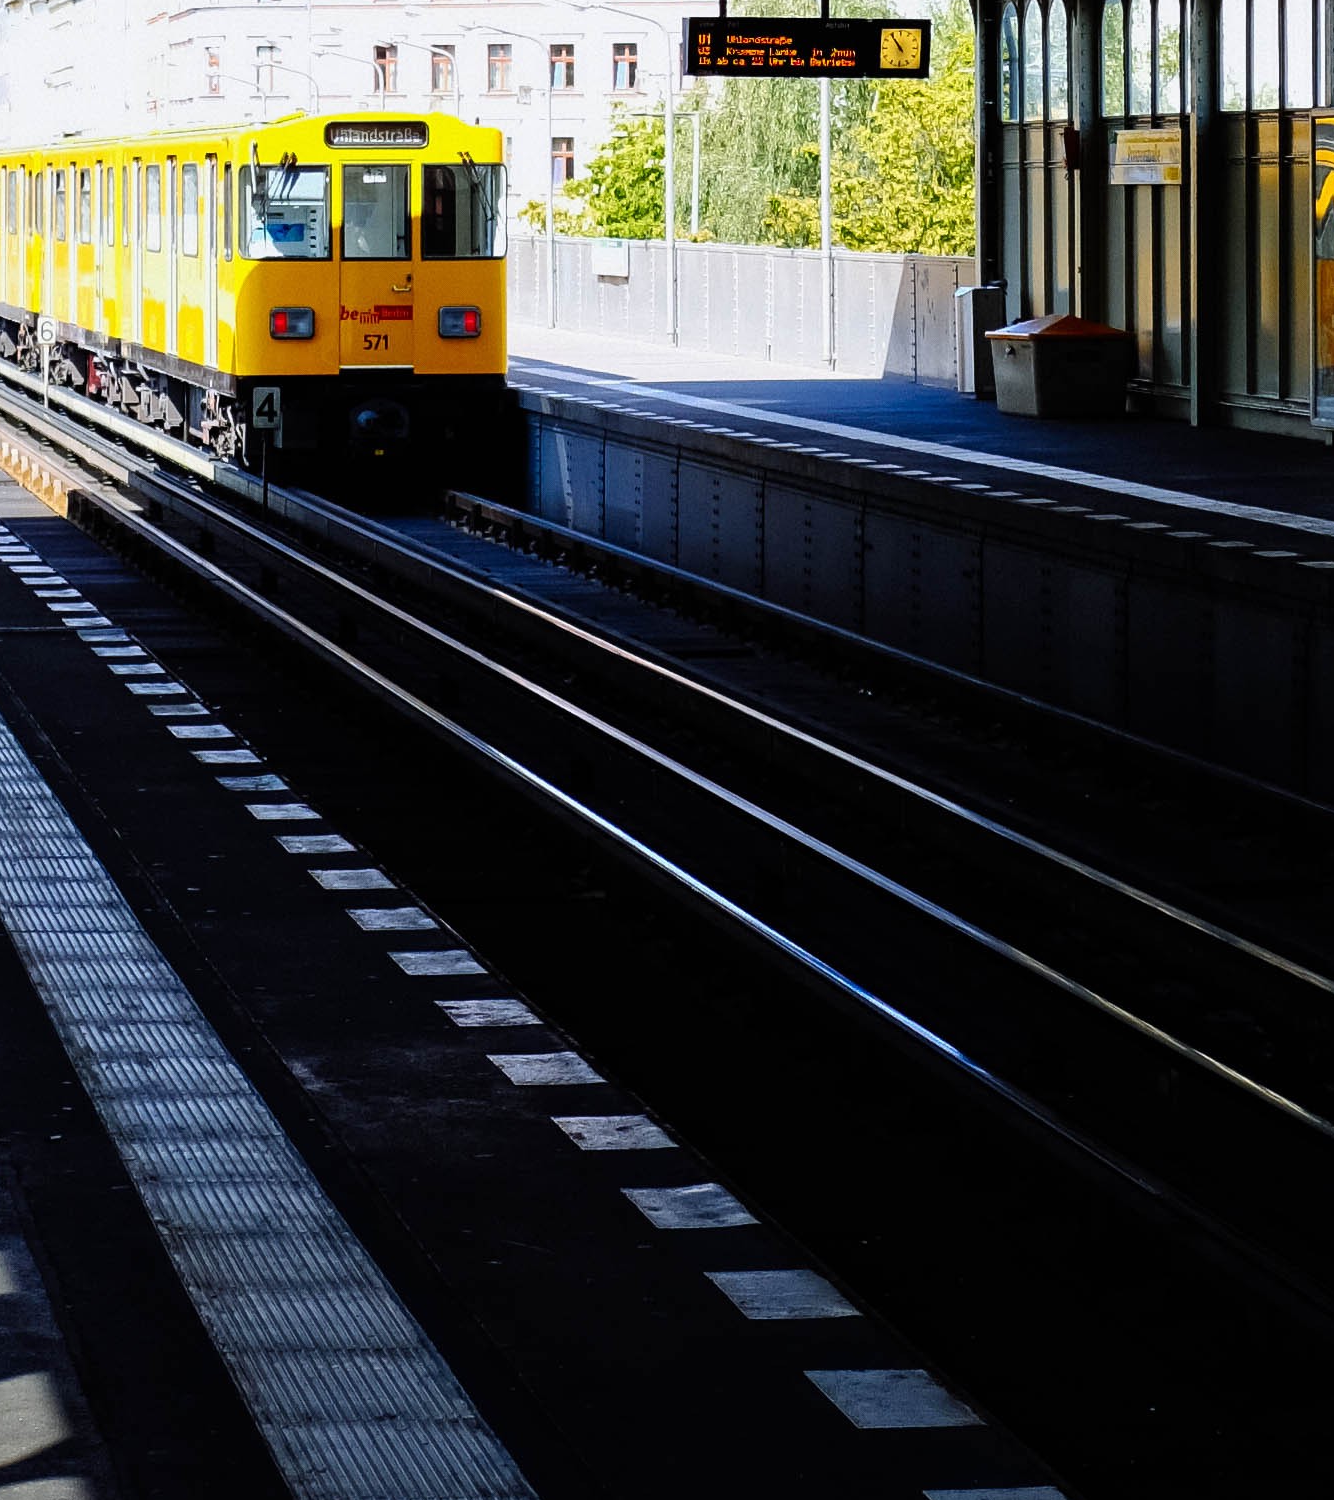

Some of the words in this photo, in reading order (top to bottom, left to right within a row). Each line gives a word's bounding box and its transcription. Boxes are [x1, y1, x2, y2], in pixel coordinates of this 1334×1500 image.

[698, 33, 711, 45] U1
[726, 35, 793, 46] Uhlandstraße
[40, 320, 54, 342] 6
[363, 334, 389, 351] 571
[255, 392, 278, 423] 4
